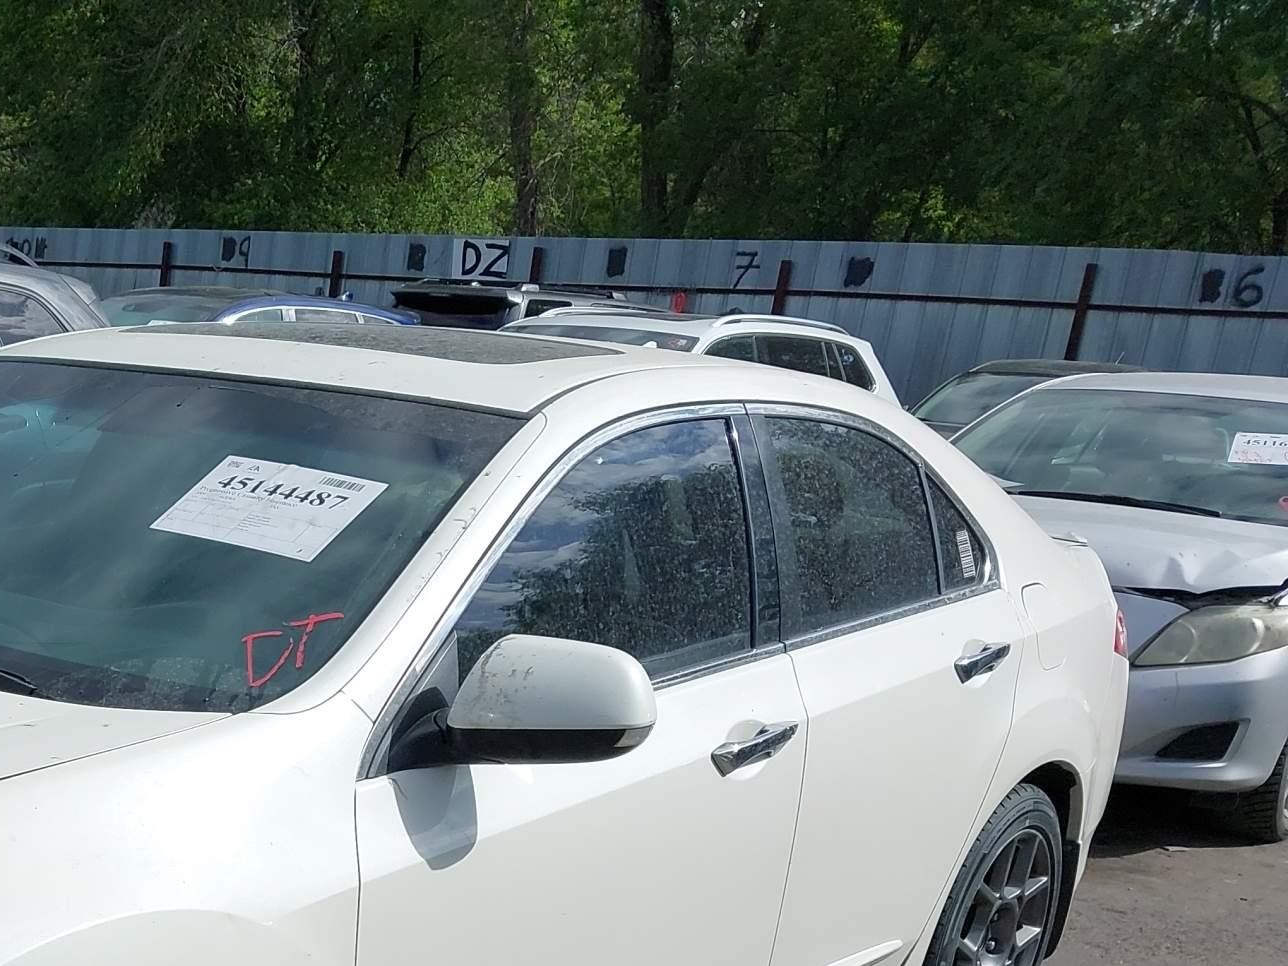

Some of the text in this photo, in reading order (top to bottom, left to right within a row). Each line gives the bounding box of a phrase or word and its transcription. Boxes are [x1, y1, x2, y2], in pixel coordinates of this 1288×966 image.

[462, 240, 510, 279] DZ
[735, 251, 761, 288] 7
[218, 475, 349, 510] 45144487
[242, 612, 345, 687] DT
